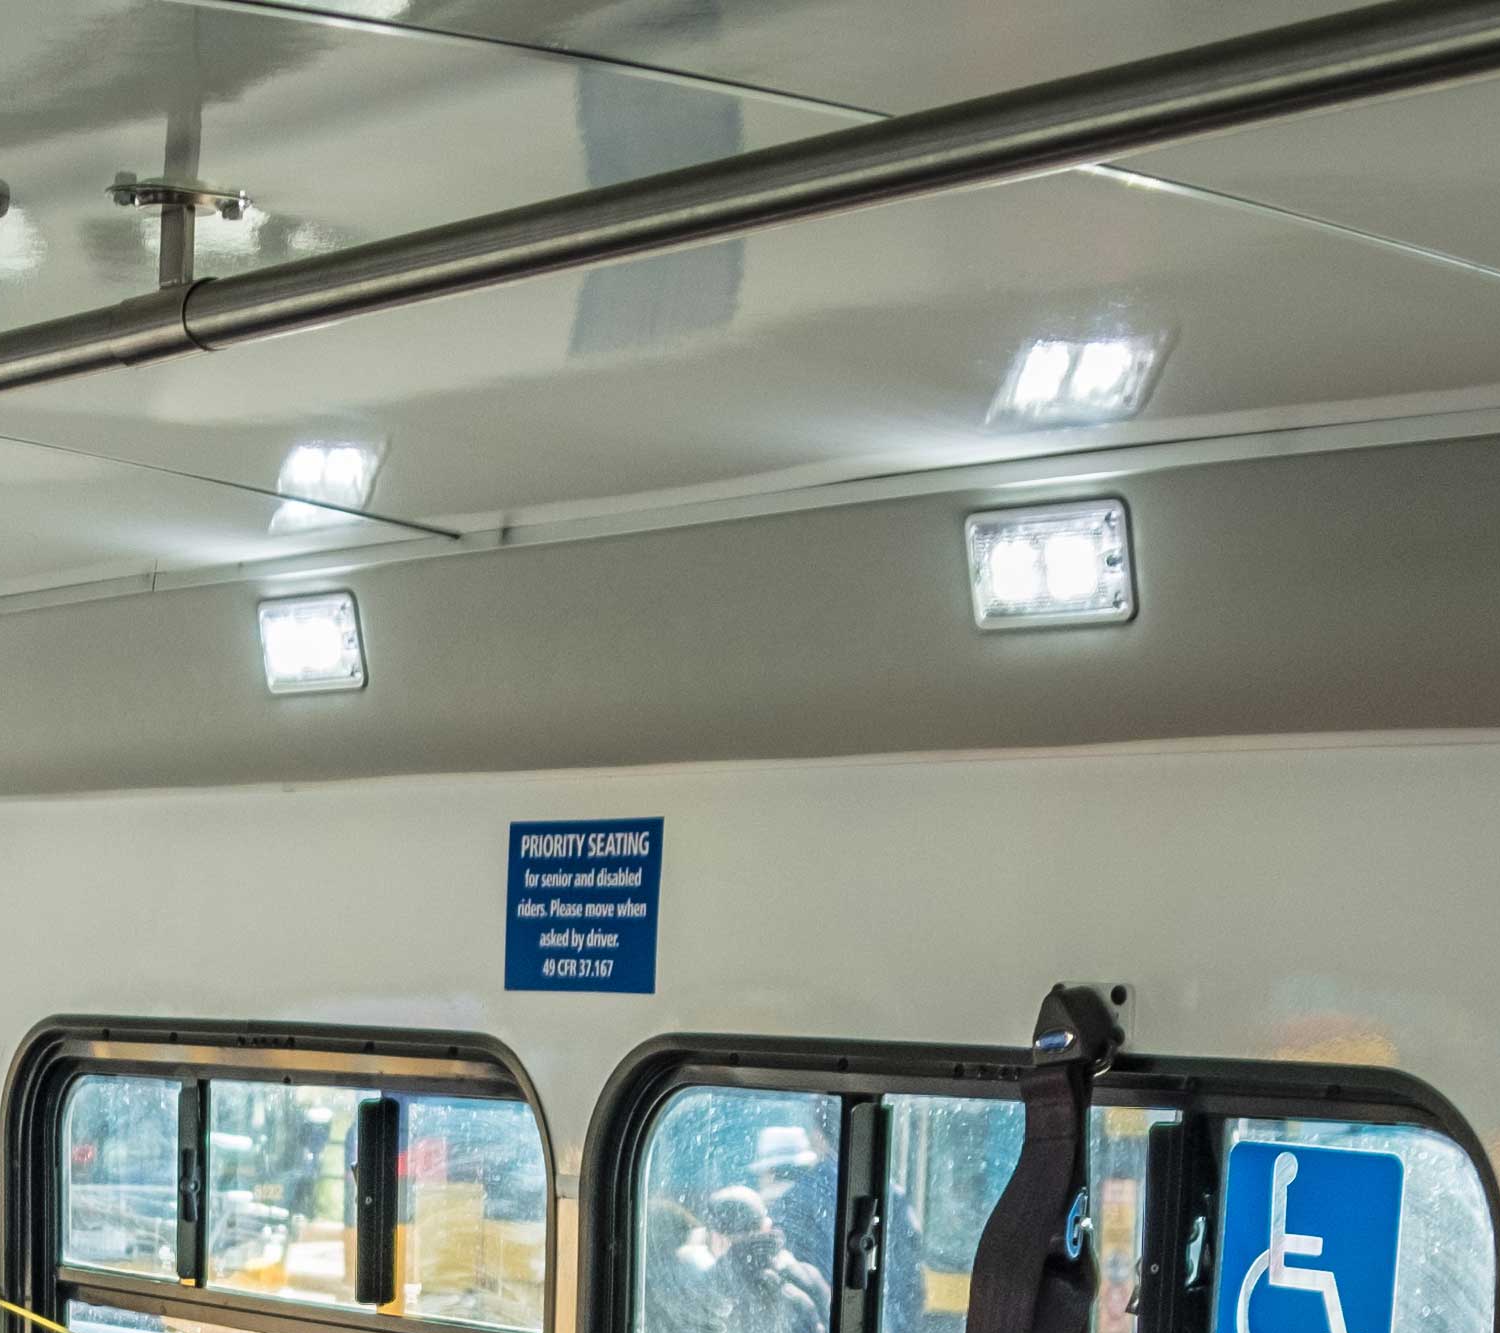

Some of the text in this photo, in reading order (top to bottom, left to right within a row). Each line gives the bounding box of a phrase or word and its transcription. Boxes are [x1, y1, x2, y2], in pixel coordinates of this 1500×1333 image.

[521, 832, 649, 858] PRIORITY SEATING
[525, 867, 642, 888] for senior and disabled
[517, 898, 647, 918] riders. Please move when
[539, 928, 620, 952] asked by driver.
[542, 958, 614, 977] 49 CFR 37.167
